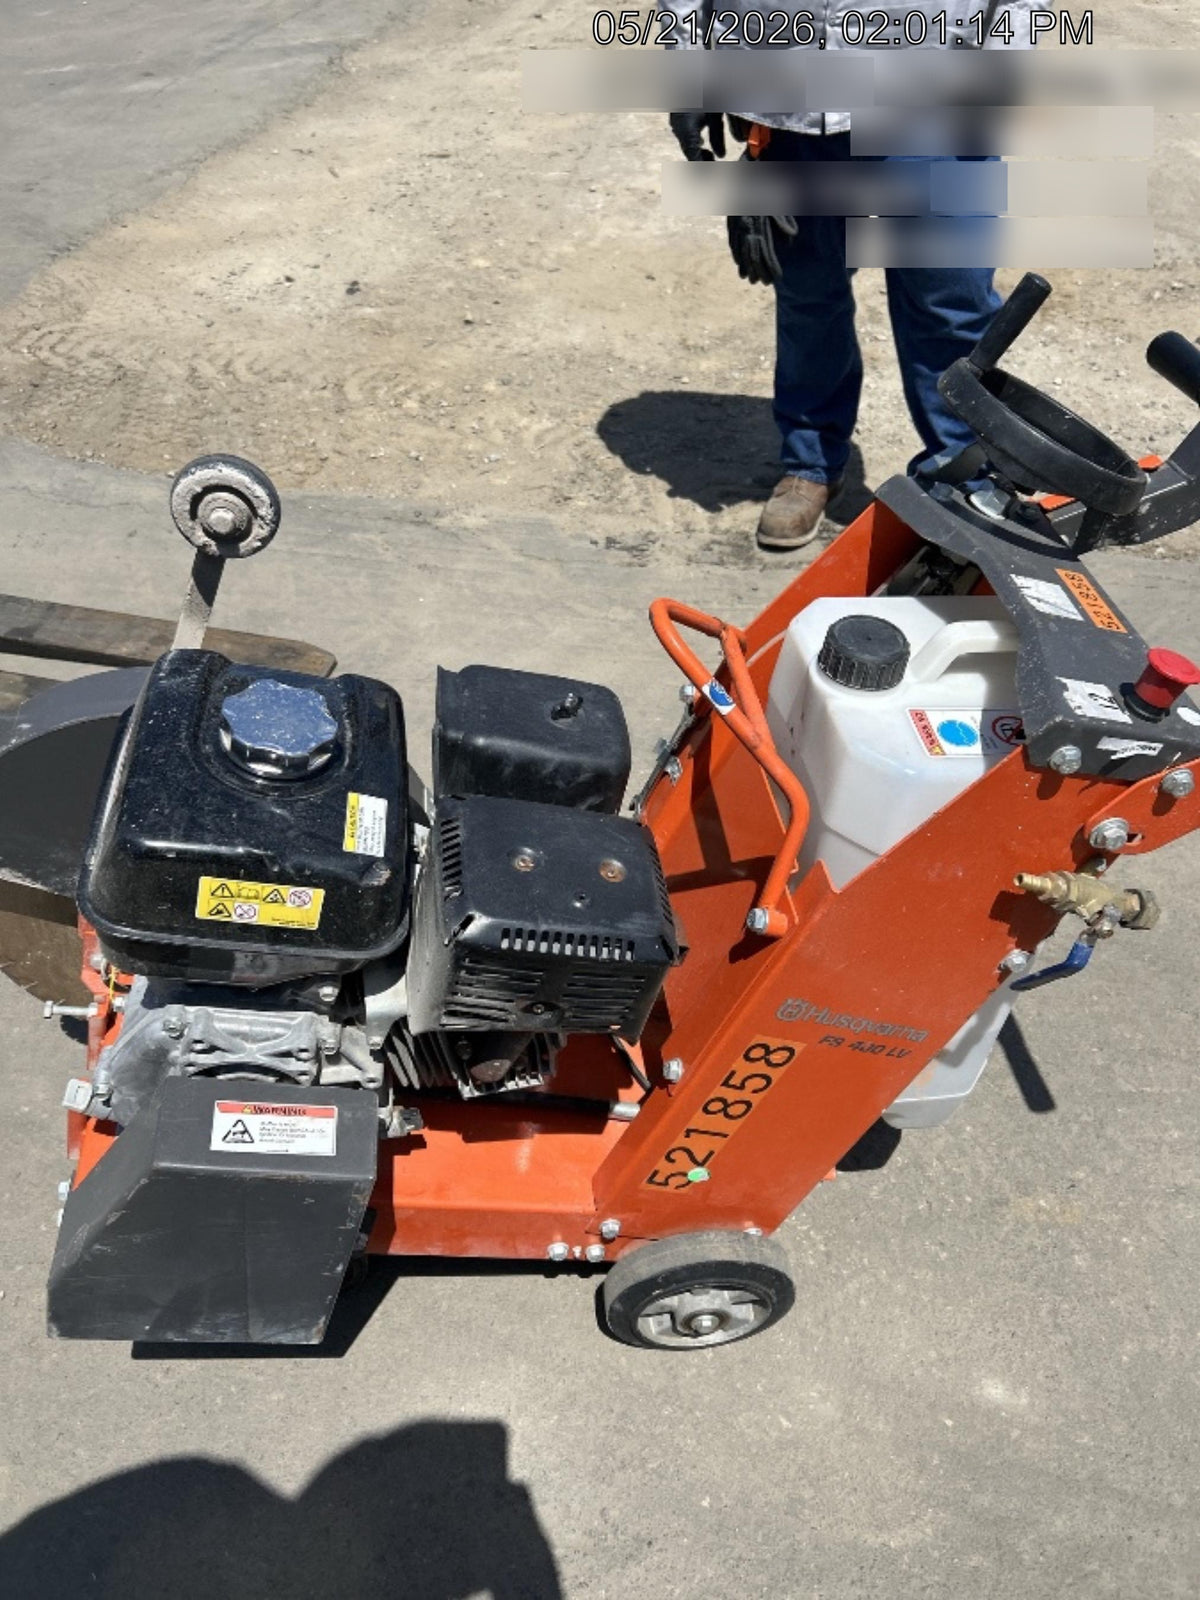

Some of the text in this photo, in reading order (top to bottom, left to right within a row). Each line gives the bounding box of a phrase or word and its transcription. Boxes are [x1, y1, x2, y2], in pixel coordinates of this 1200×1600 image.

[801, 1004, 929, 1043] Husqvarna
[818, 1034, 846, 1048] FS
[885, 1047, 912, 1059] LV
[645, 1042, 796, 1190] 521858
